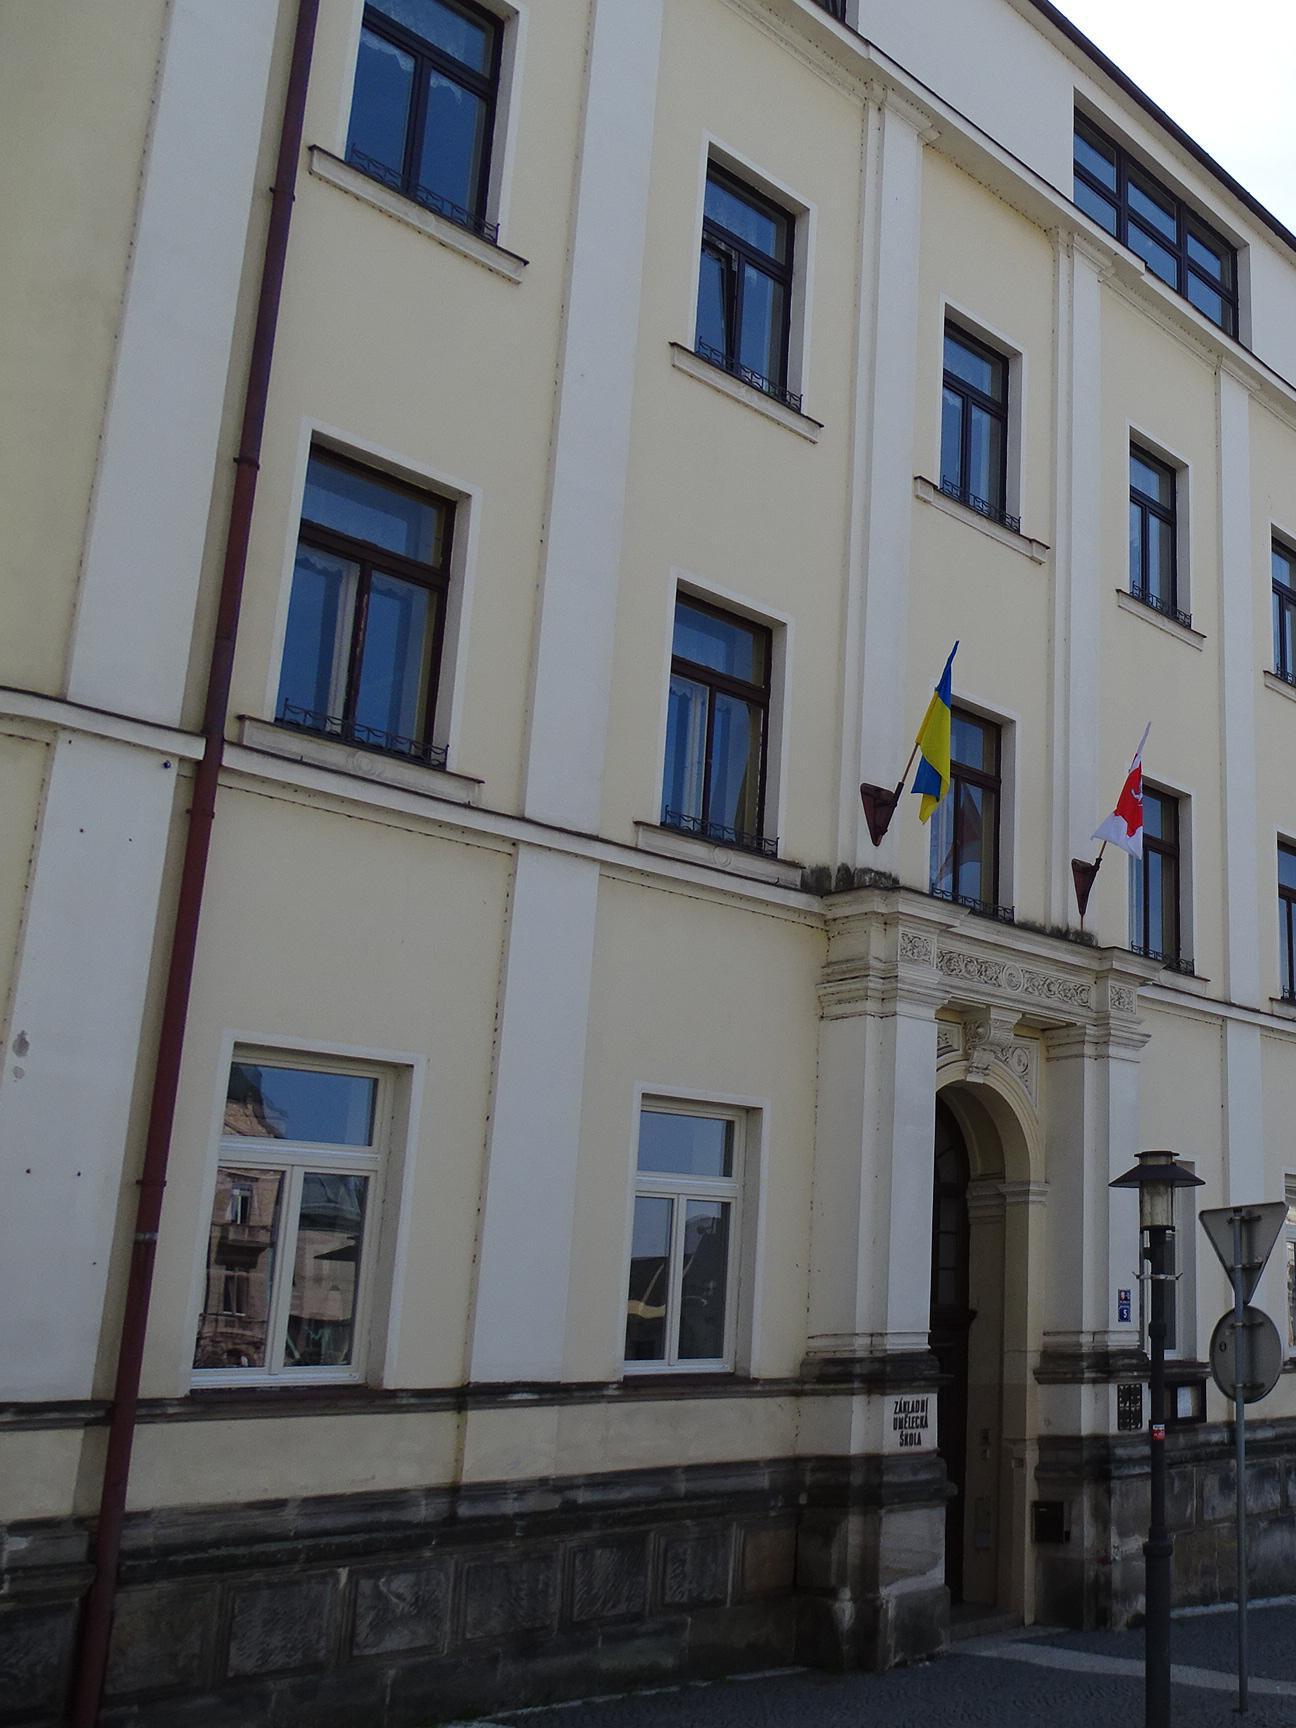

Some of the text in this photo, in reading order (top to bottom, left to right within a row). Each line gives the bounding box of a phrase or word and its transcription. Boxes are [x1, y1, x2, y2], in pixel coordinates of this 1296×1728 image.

[893, 1397, 929, 1414] ZÁKLADNÍ
[893, 1413, 929, 1430] UMĚLECKÁ
[899, 1430, 922, 1447] ŠKOLA
